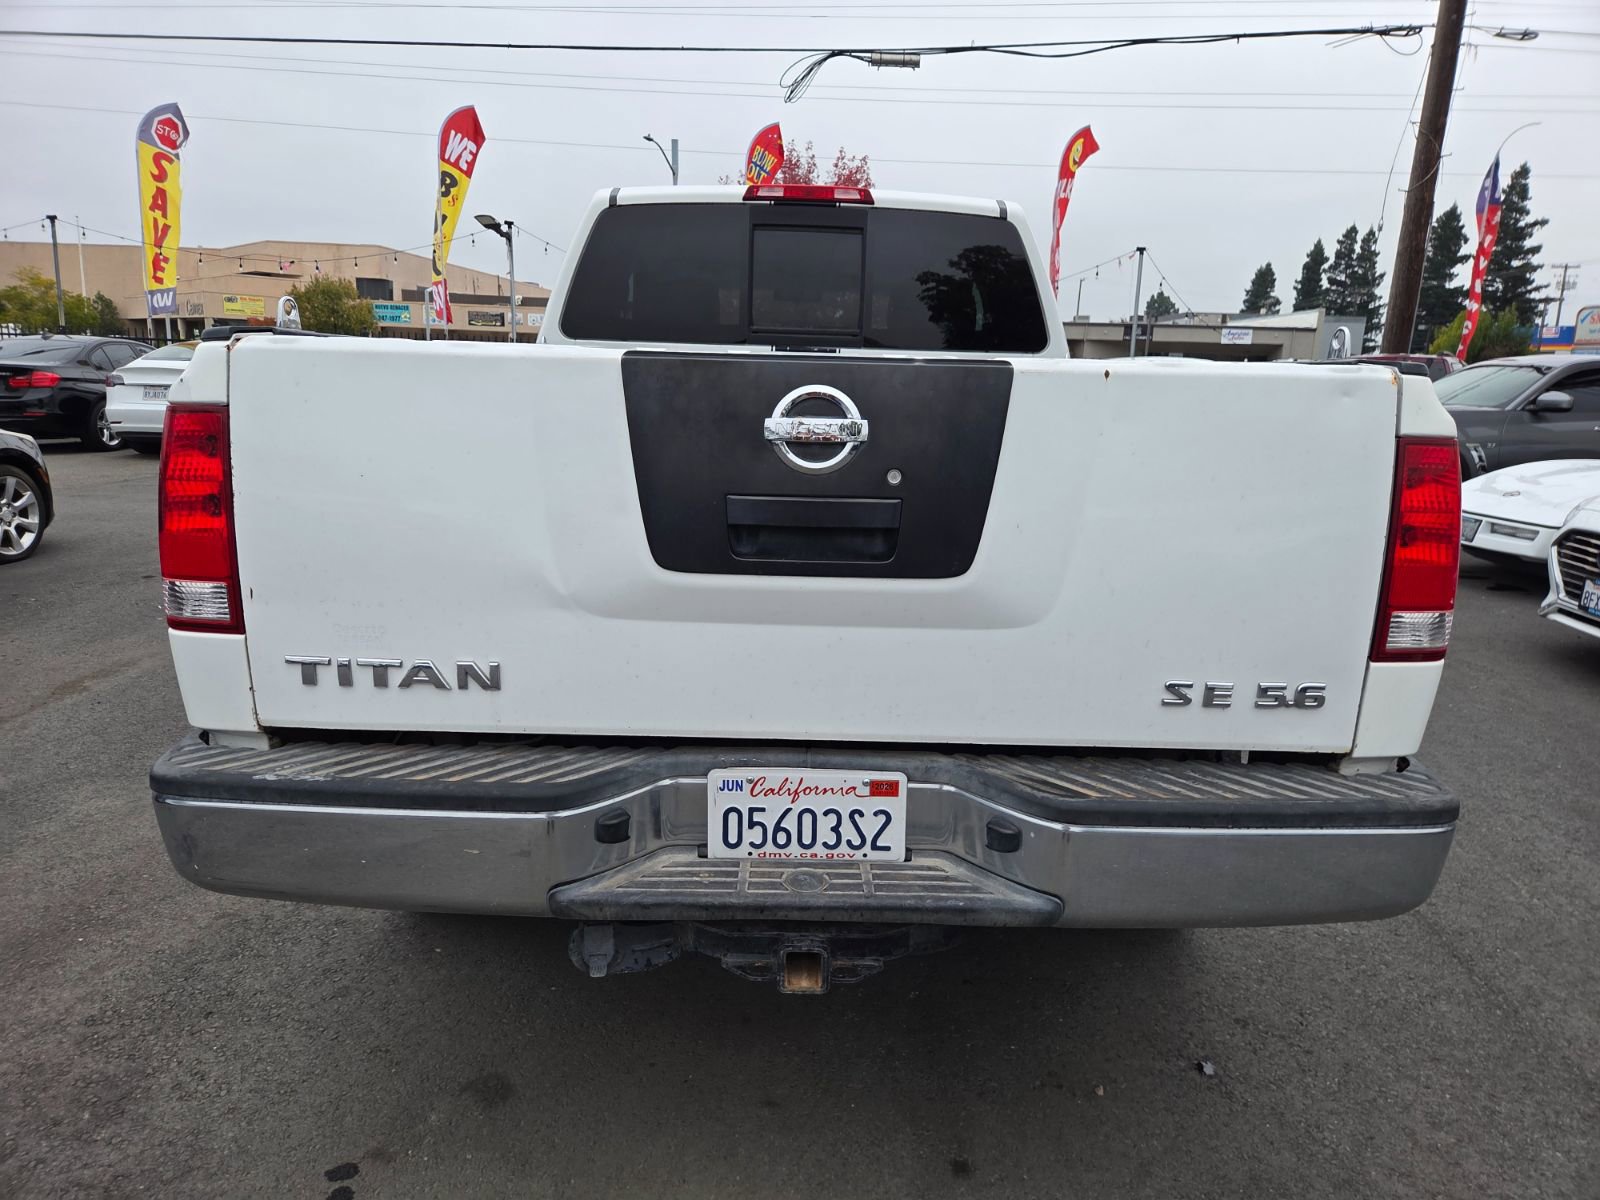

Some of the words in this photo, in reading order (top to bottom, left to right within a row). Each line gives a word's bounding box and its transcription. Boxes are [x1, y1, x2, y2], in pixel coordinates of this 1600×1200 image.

[444, 129, 477, 171] WE
[752, 145, 778, 172] BLOW
[747, 163, 768, 186] OUT
[149, 151, 175, 285] SAVE
[774, 422, 863, 437] NISSAN
[285, 655, 501, 691] TITAN
[1161, 680, 1235, 708] SE
[1254, 681, 1327, 709] 5.6
[718, 779, 743, 792] JUN
[750, 776, 870, 804] California
[722, 806, 893, 851] 05603S2
[757, 850, 856, 859] dmv.ca.gov
